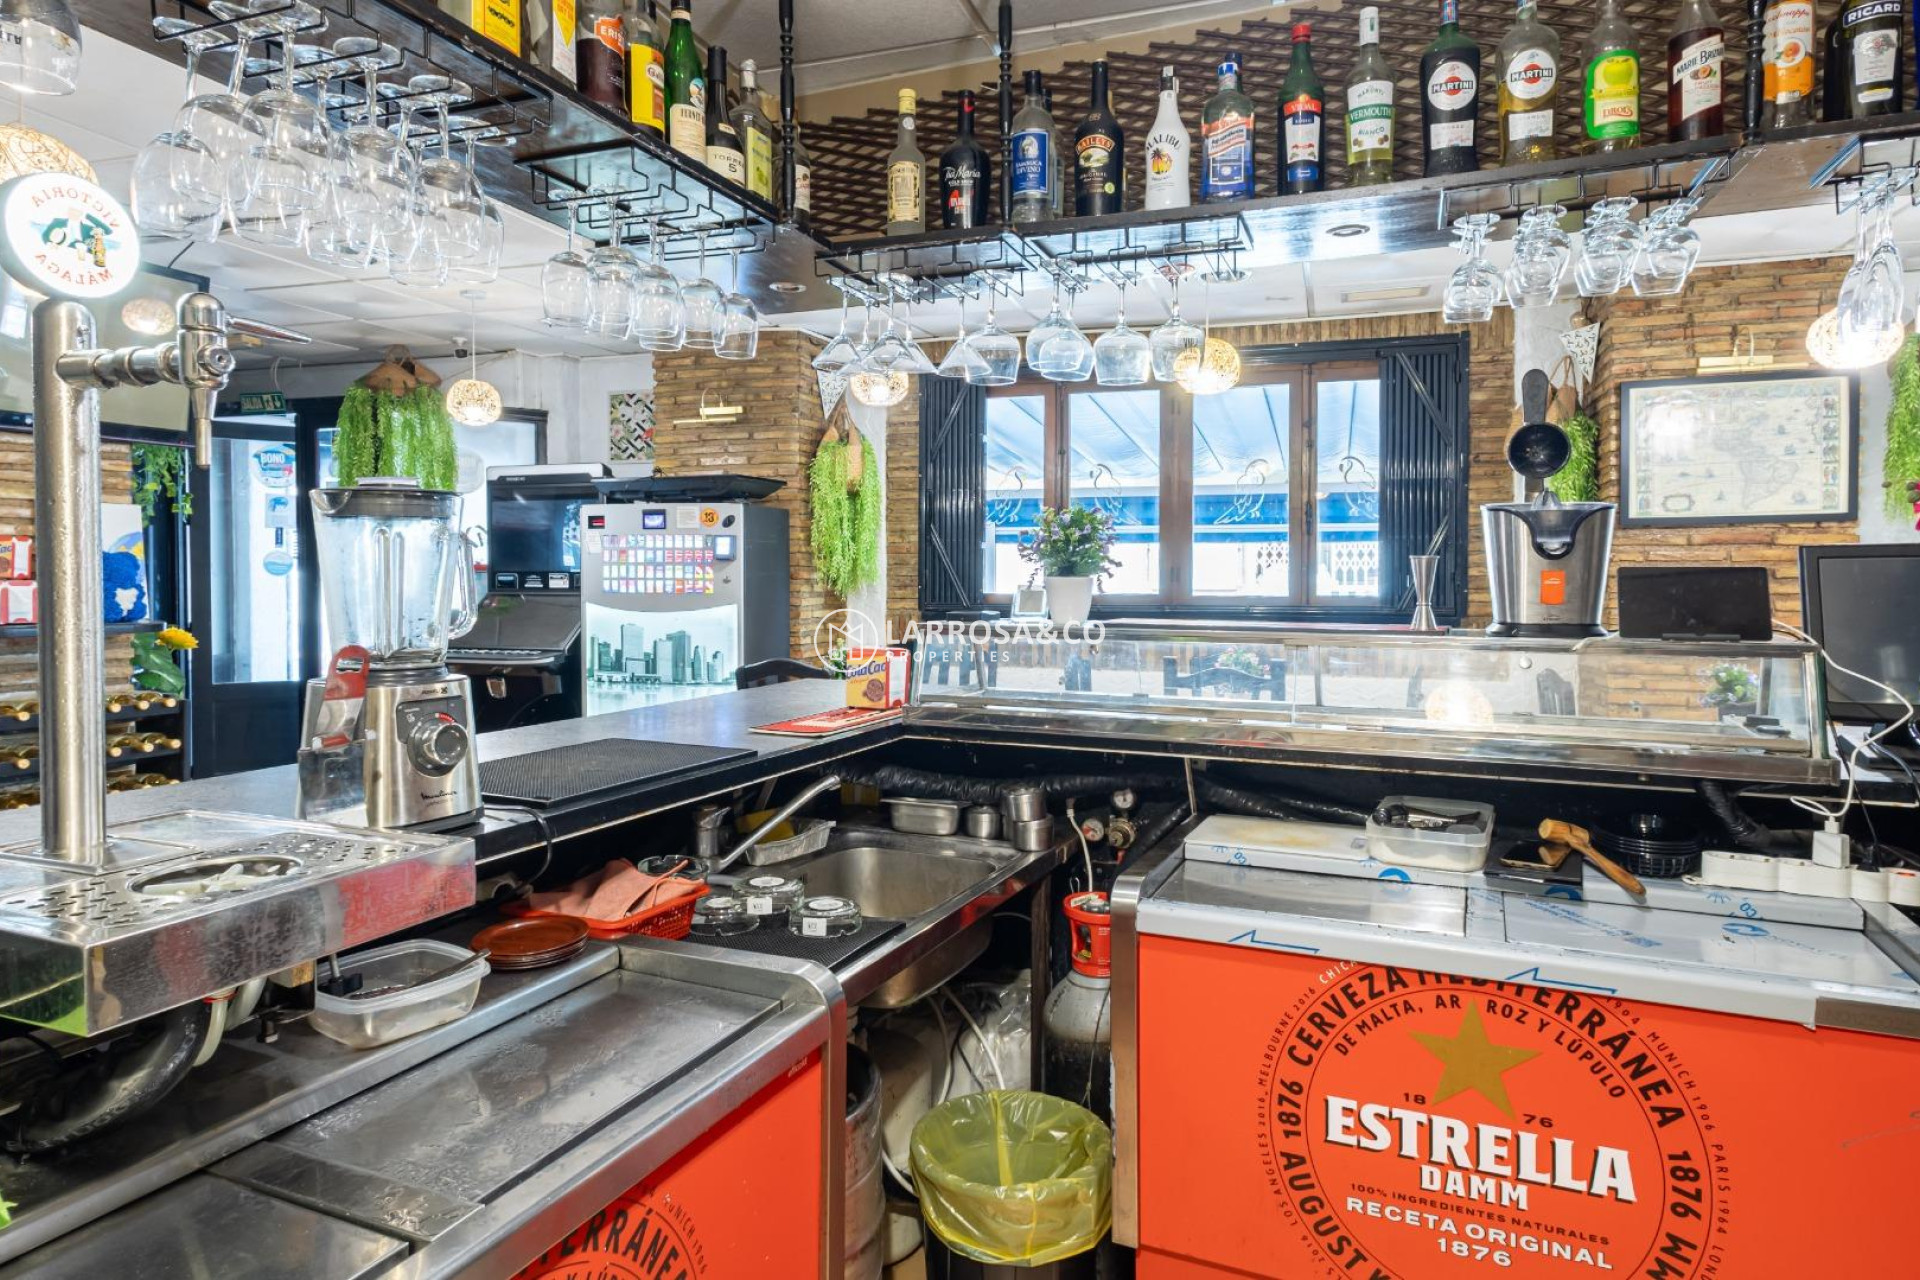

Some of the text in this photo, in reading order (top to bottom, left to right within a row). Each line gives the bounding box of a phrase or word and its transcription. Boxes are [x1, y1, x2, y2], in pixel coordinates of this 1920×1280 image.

[1847, 3, 1900, 22] RICARD
[1433, 81, 1473, 94] MARTINI
[1512, 69, 1552, 81] MARTINI
[1677, 58, 1697, 76] MARIE
[1350, 106, 1391, 121] VERMOUTH
[1078, 137, 1112, 152] BAILEYS
[1146, 133, 1182, 152] MALIBU
[1258, 987, 1316, 1087] MELBOURNE 2016
[1334, 1033, 1357, 1056] DE
[1355, 1000, 1423, 1036] MALTA,
[1537, 1018, 1550, 1033] Y
[1554, 1031, 1625, 1097] LÚPULO
[1647, 1031, 1696, 1089] MUNICH
[1277, 965, 1703, 1221] 1876 CERVEZA ERRÁNEA 1876
[1403, 1092, 1554, 1128] 18 76
[1692, 1096, 1715, 1131] 1906
[1259, 1133, 1282, 1196] ANGELES
[1324, 1095, 1637, 1204] ESTRELLA
[1711, 1144, 1732, 1192] PARIS
[1419, 1164, 1529, 1211] DAMM
[1280, 1151, 1368, 1270] AUGUST
[1351, 1183, 1611, 1245] 100% INGREDIENTES NATURALES
[1716, 1201, 1730, 1235] 1964
[1346, 1196, 1614, 1270] RECETA ORIGINAL
[1437, 1237, 1513, 1267] 1876
